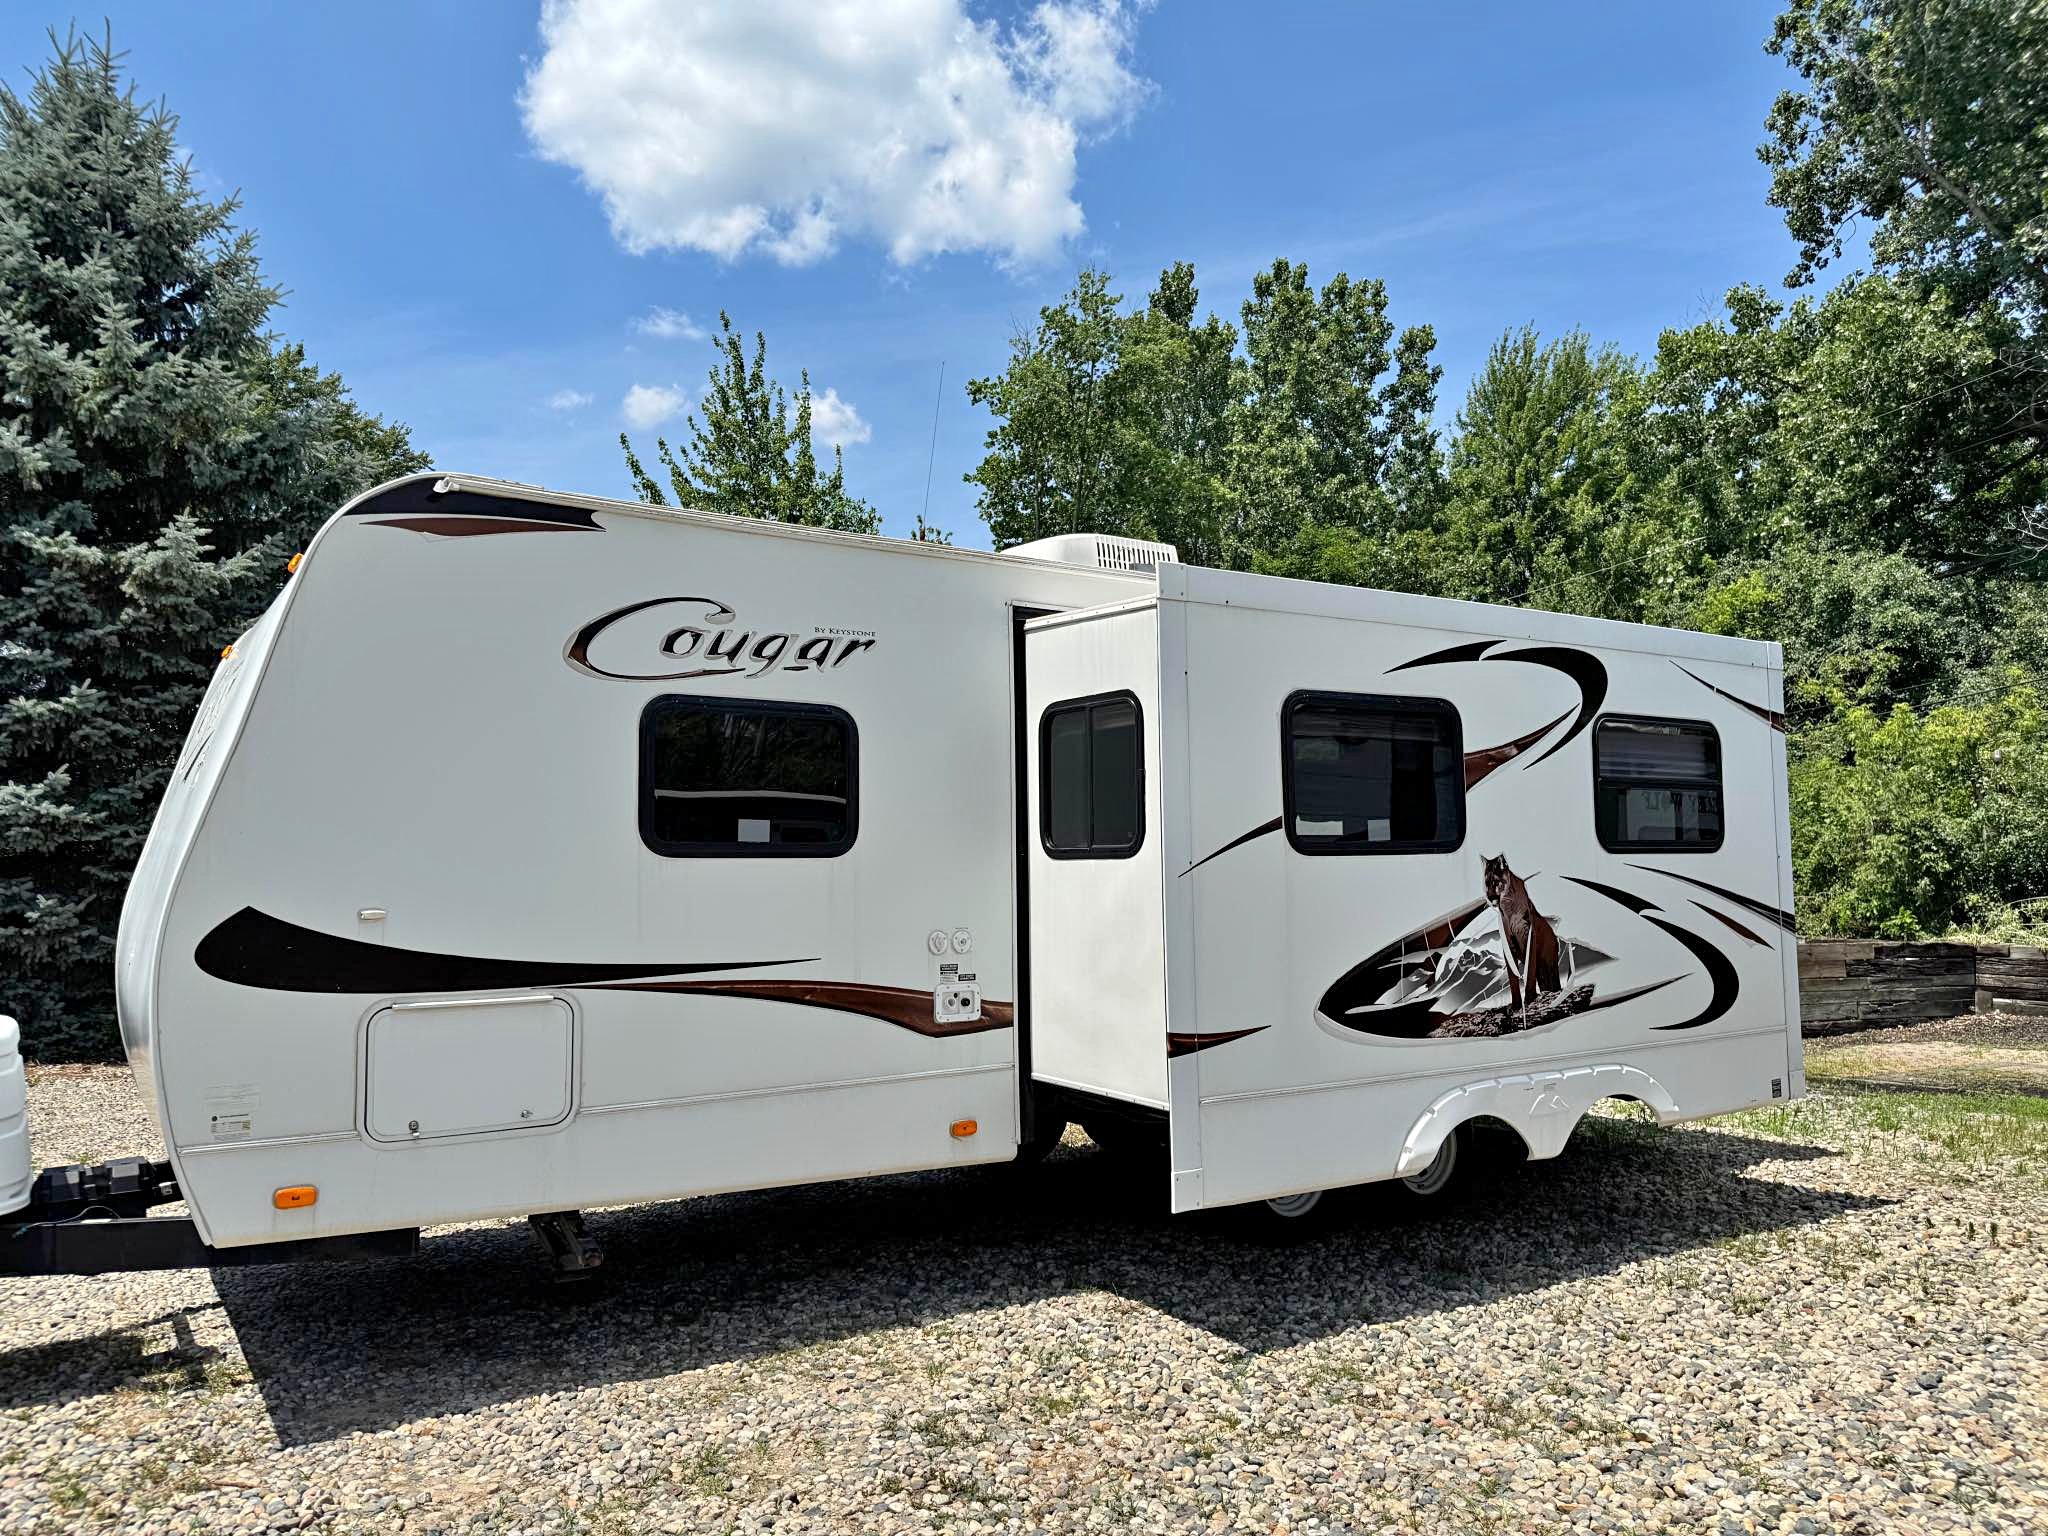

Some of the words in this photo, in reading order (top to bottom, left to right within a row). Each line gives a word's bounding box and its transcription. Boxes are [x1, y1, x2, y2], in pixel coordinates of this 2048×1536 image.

[562, 596, 878, 681] Cougar
[814, 626, 826, 634] BY
[829, 627, 876, 638] KEYSTONE
